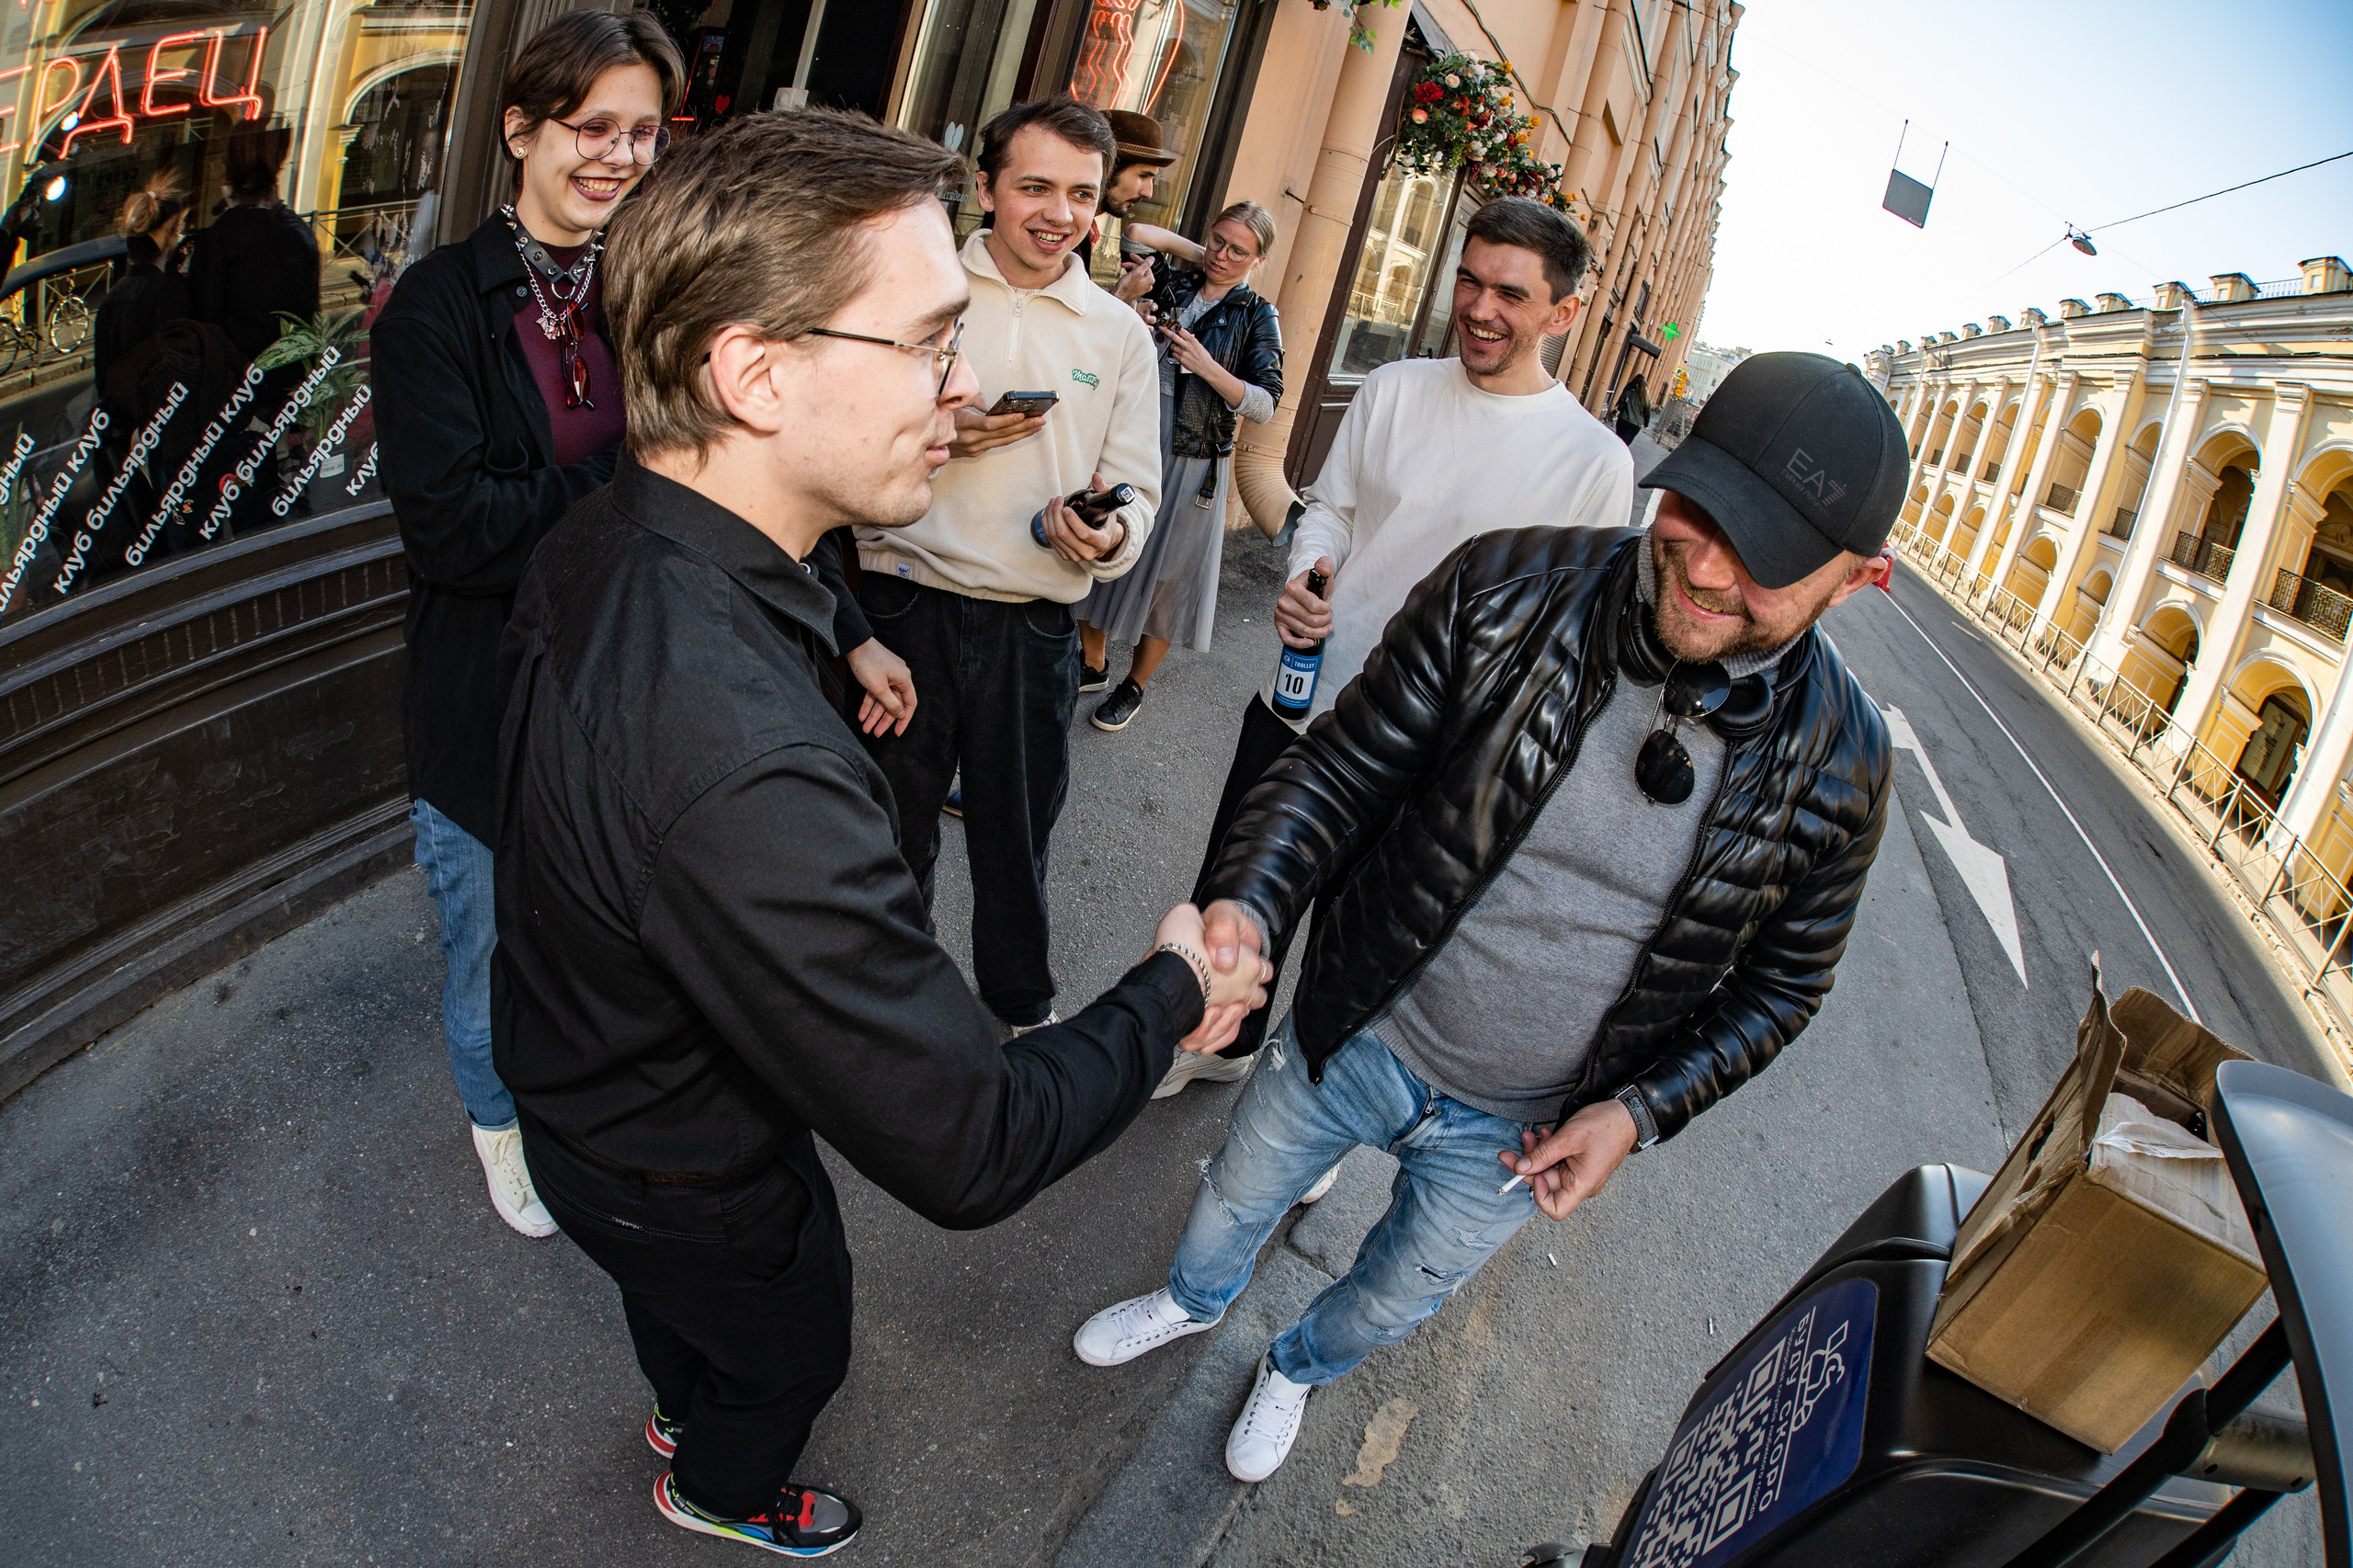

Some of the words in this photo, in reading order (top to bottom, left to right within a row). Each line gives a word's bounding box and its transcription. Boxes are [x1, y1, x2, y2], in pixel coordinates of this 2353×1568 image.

[53, 530, 92, 595] клуб
[86, 381, 189, 530] бильярдный
[67, 407, 110, 473] клуб
[125, 421, 224, 566] бильярдный
[219, 363, 265, 424] клуб
[199, 479, 241, 540] клуб
[235, 345, 342, 483] бильярдный
[271, 384, 371, 517] бильярдный
[1786, 448, 1846, 506] EA7
[1285, 673, 1304, 695] 10
[1786, 1312, 1810, 1385] БУДУ
[1758, 1400, 1791, 1512] СКОРО
